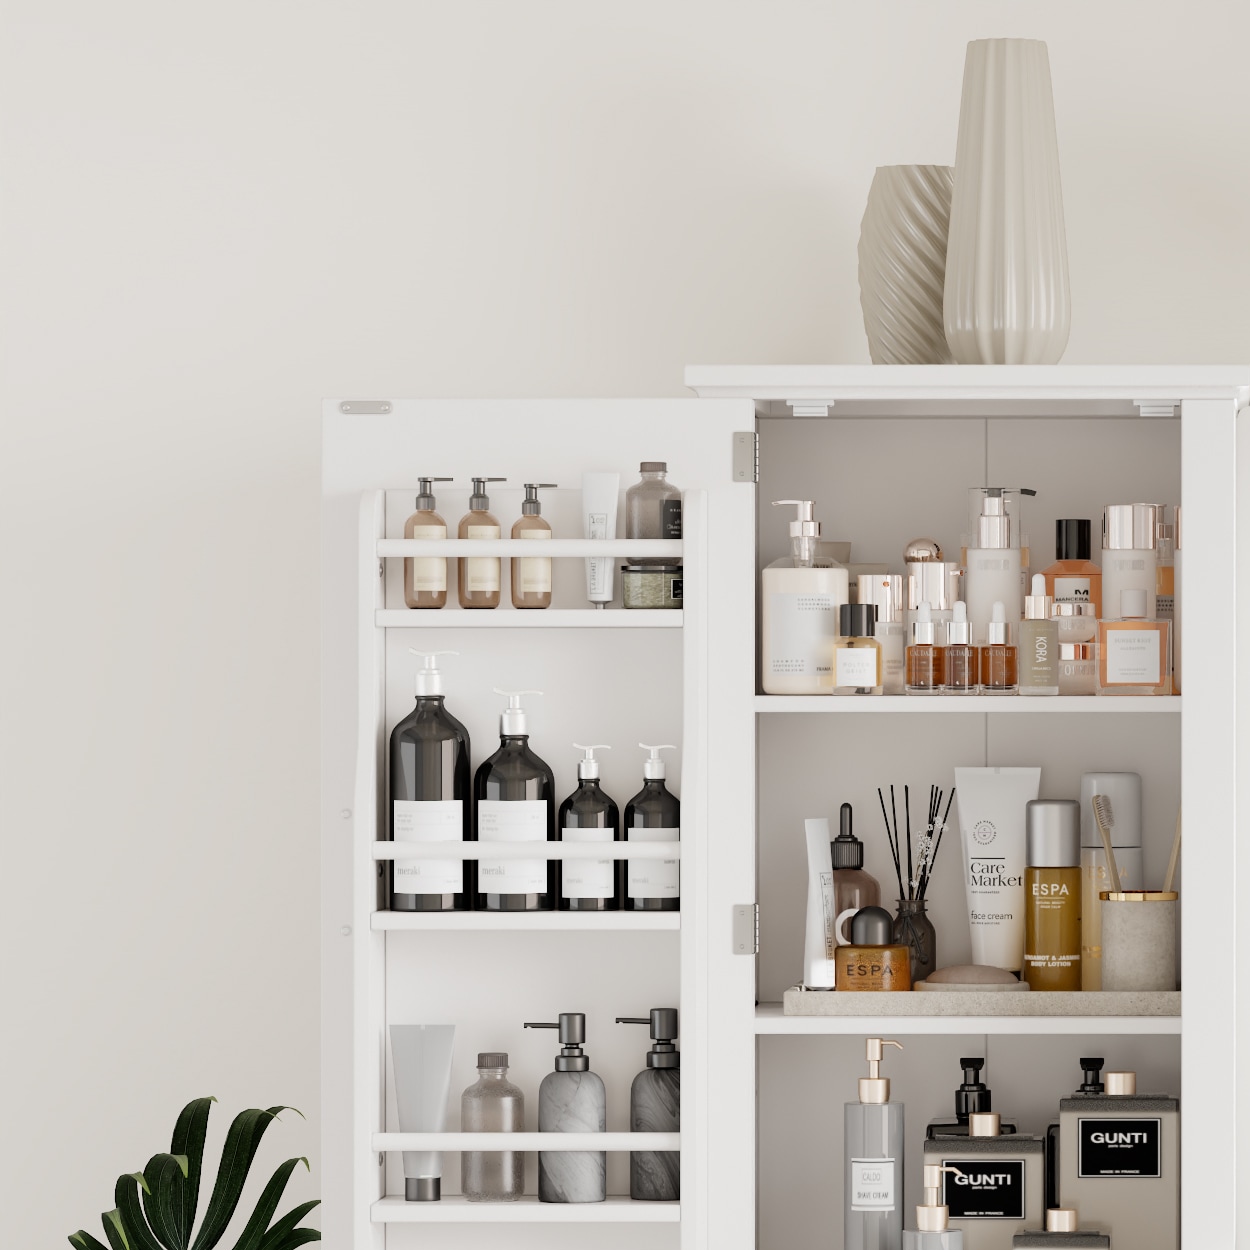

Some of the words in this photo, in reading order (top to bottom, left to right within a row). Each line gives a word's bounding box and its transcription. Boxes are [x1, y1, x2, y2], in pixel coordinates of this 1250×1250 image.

[1036, 636, 1047, 663] KORA
[397, 866, 420, 876] meraki
[482, 866, 505, 876] meraki
[971, 862, 1005, 873] Care
[971, 875, 1022, 886] Market
[1032, 884, 1069, 895] ESPA
[971, 910, 986, 919] face
[847, 965, 893, 976] ESPA
[1090, 1132, 1147, 1144] GUNTI
[954, 1174, 1011, 1185] GUNTI
